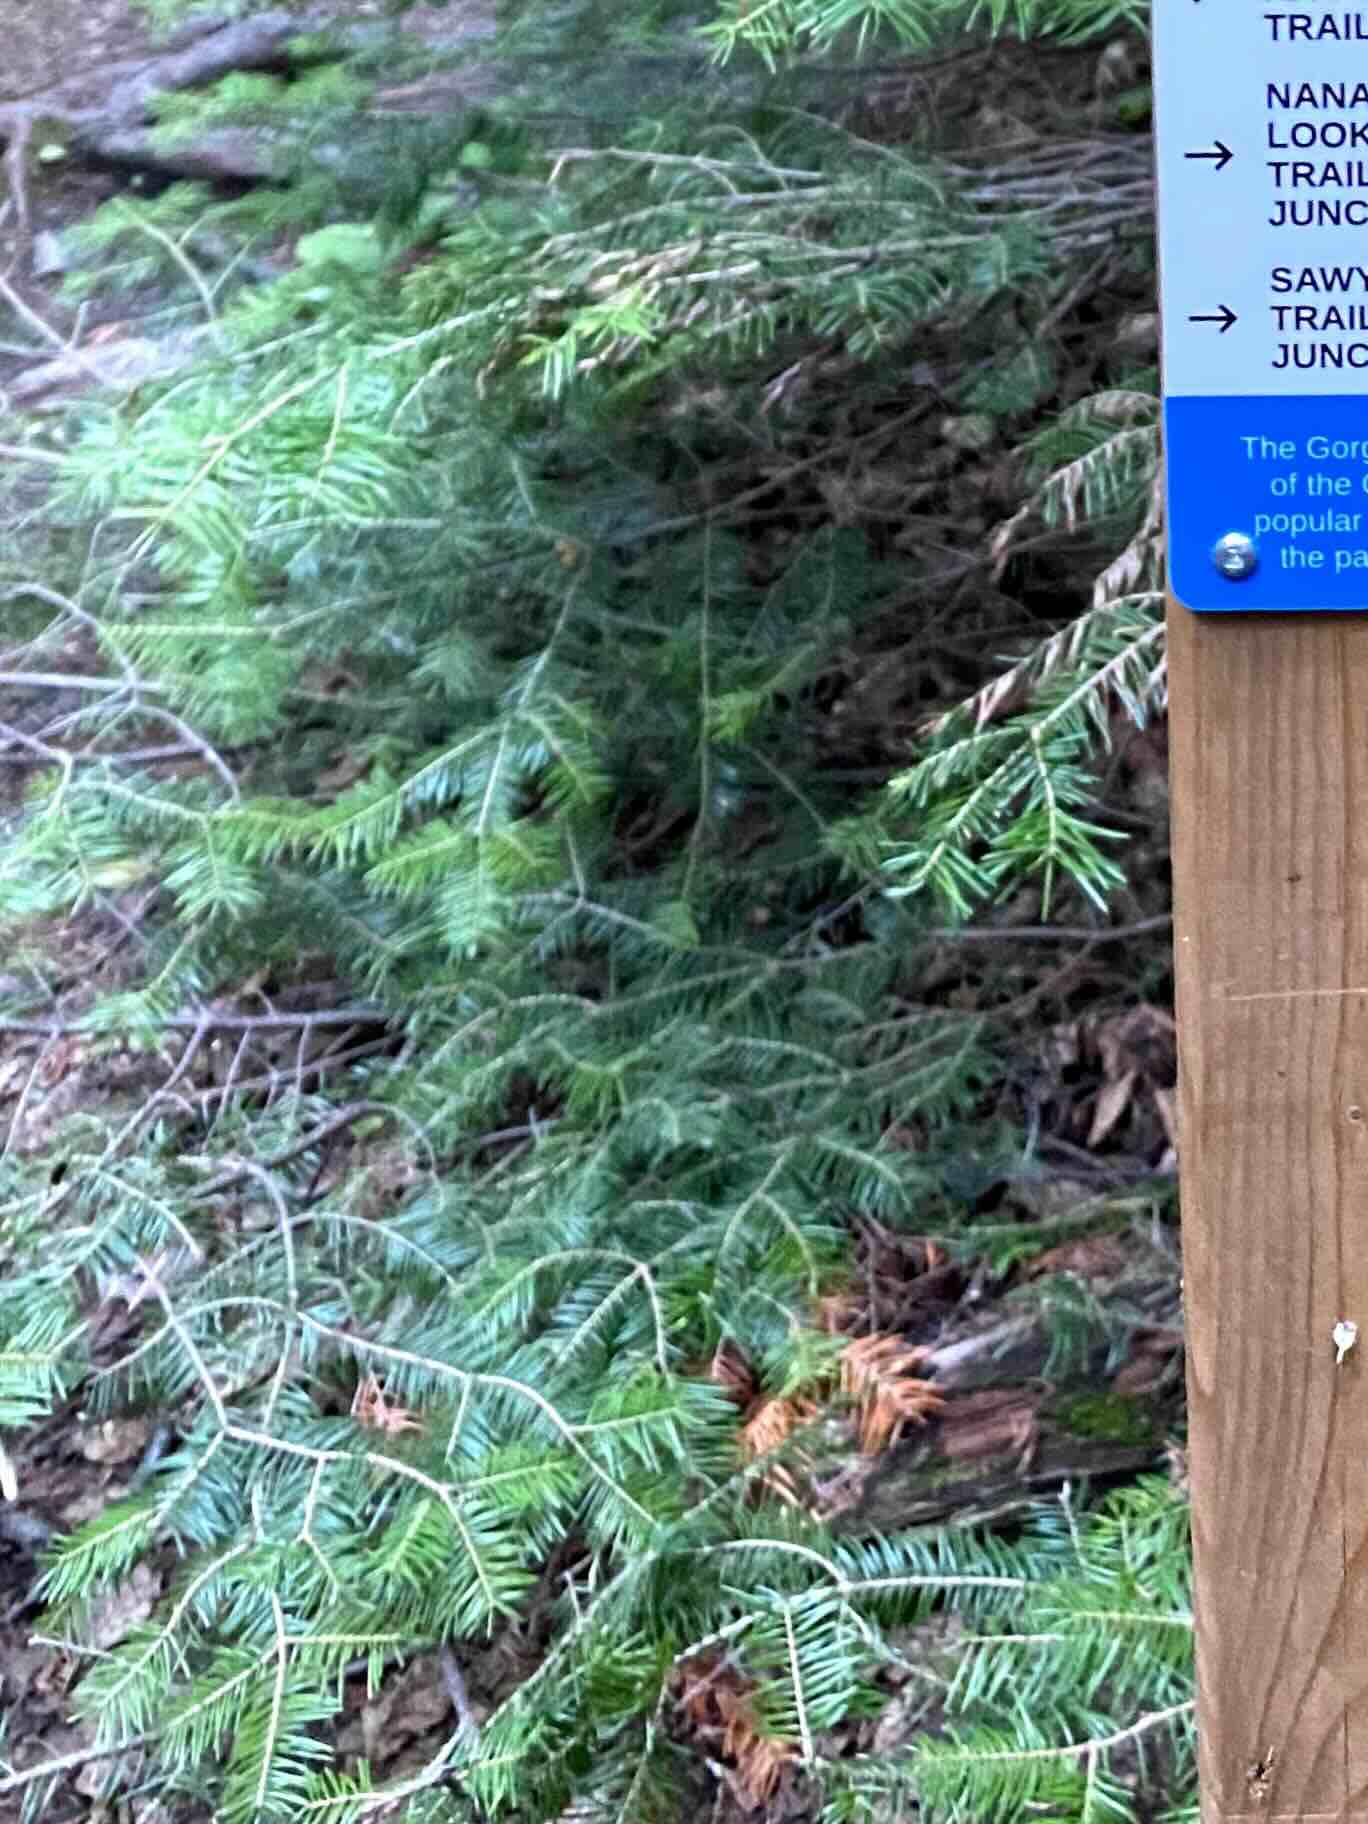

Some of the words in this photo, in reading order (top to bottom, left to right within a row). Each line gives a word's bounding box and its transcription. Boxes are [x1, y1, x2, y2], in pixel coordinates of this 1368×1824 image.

[1240, 436, 1296, 459] The
[1271, 472, 1296, 496] of
[1308, 473, 1351, 496] the
[1255, 509, 1361, 539] popular
[1281, 546, 1324, 568] the
